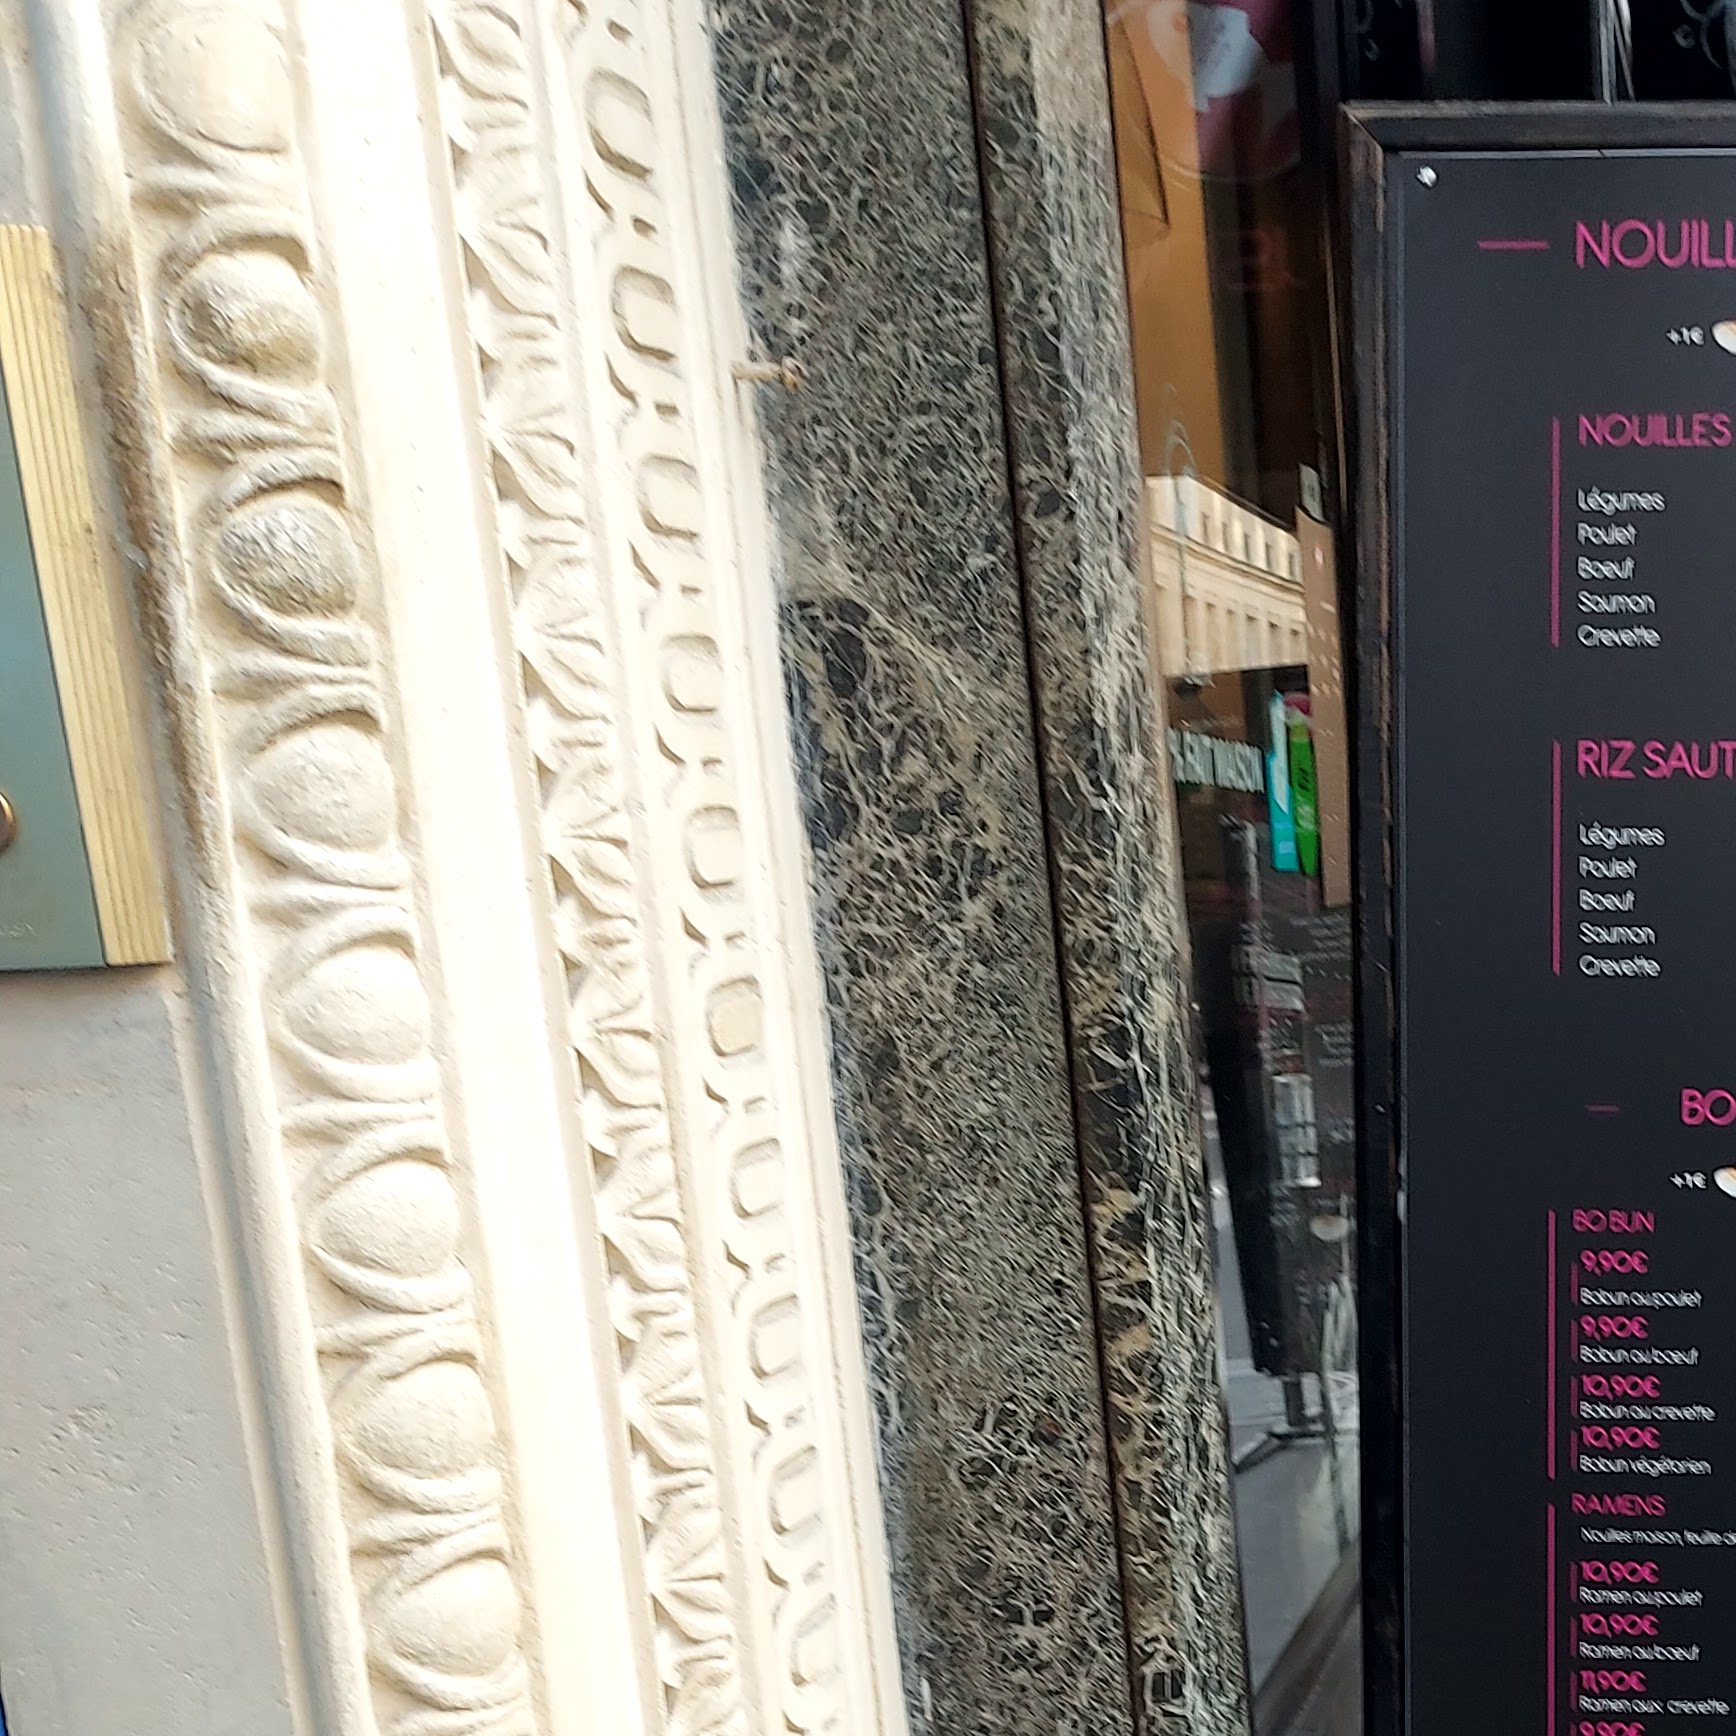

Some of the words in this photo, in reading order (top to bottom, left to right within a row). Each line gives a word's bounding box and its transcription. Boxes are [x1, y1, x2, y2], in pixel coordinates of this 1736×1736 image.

[1577, 413, 1732, 448] NOUILLES
[1577, 485, 1665, 516] Légumes
[1577, 522, 1638, 546] Poulet
[1577, 590, 1655, 614] Saumon
[1577, 624, 1661, 648] Crevette
[1577, 739, 1636, 779] RIZ
[1578, 821, 1665, 850] Légumes
[1578, 856, 1638, 879] Poulet
[1578, 921, 1656, 945] Saumon
[1578, 954, 1662, 978] Crevette
[1680, 1088, 1736, 1127] BO
[1580, 1250, 1649, 1277] 9,90€
[1580, 1314, 1649, 1341] 9,90€
[1581, 1374, 1661, 1401] 10,90€
[1581, 1426, 1661, 1451] 10,90€
[1571, 1493, 1667, 1517] RAMENS
[1580, 1560, 1660, 1586] 10,90€
[1579, 1612, 1659, 1639] 10,90€
